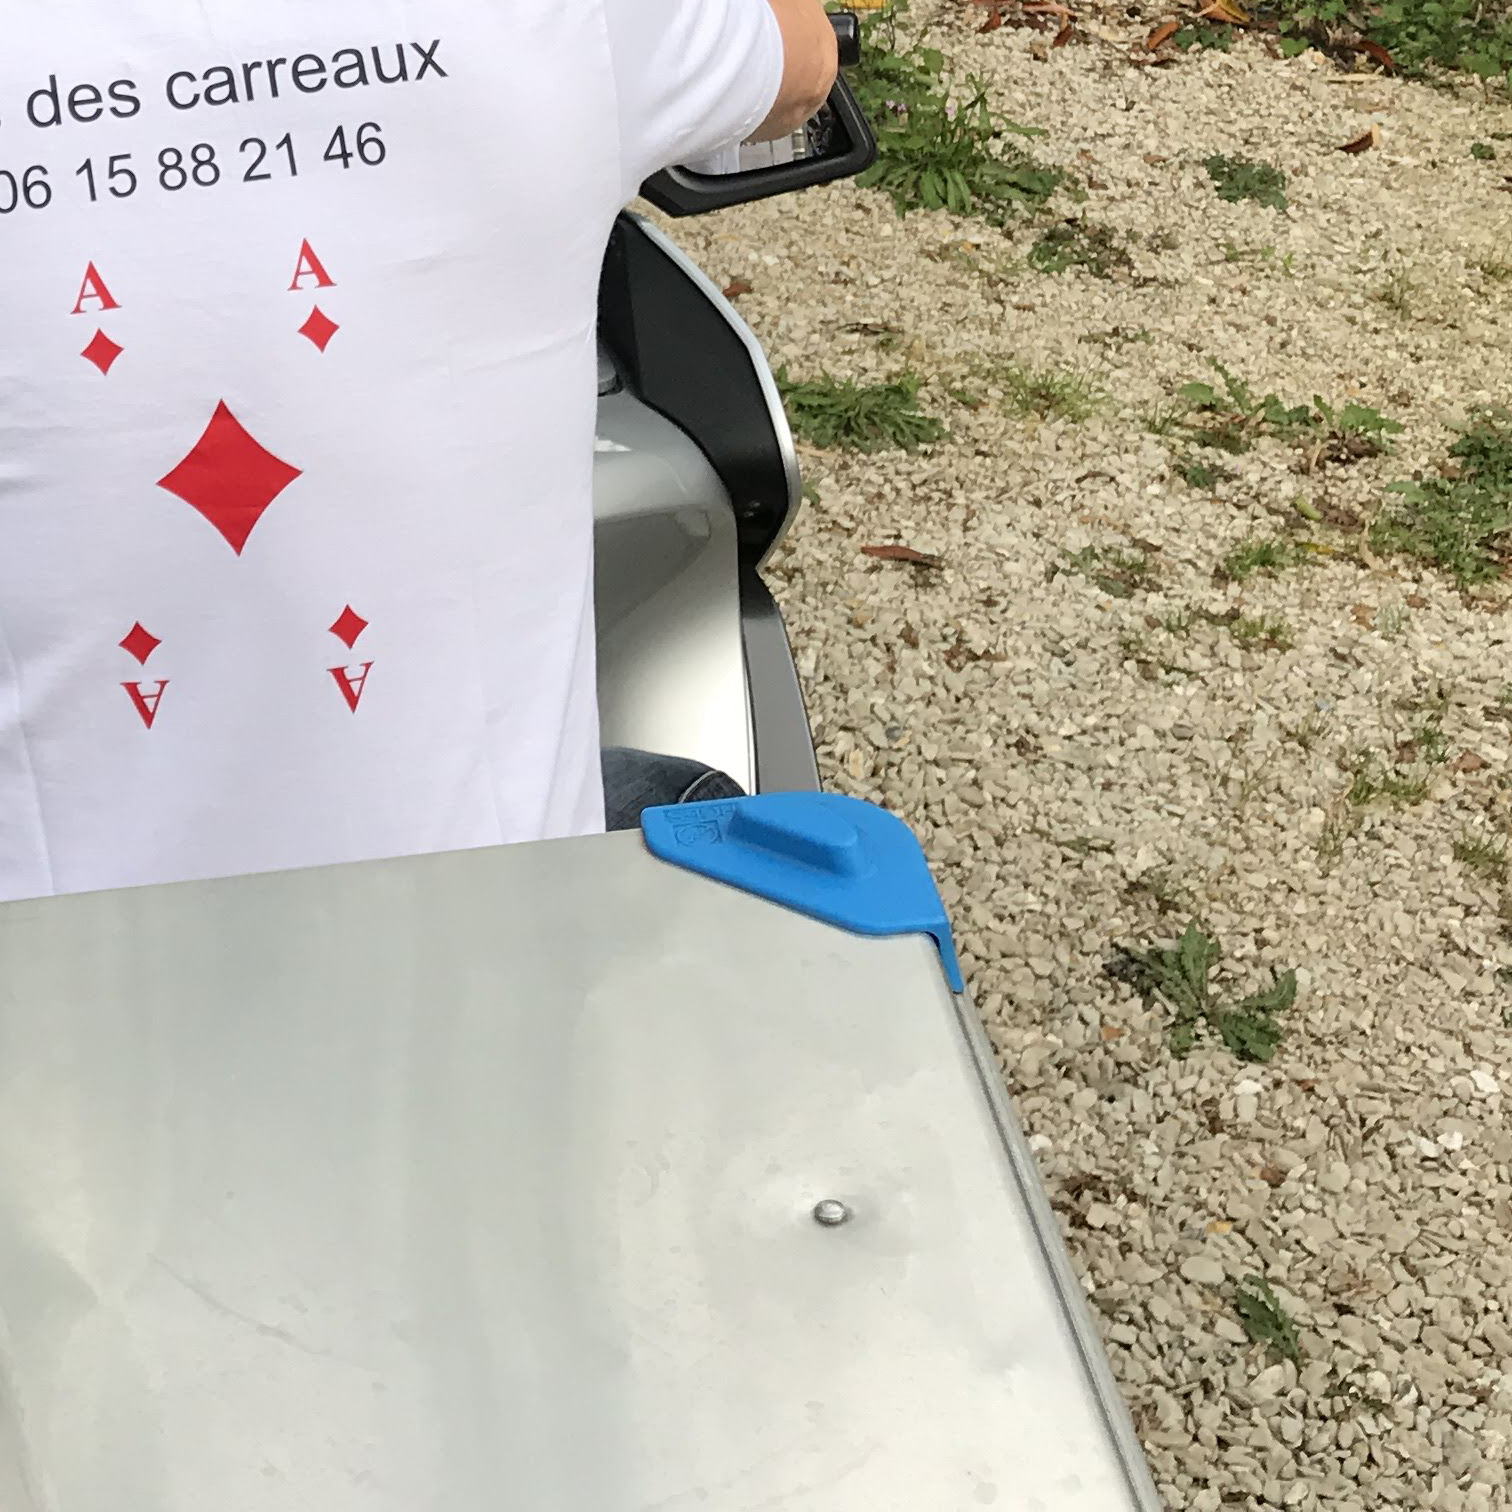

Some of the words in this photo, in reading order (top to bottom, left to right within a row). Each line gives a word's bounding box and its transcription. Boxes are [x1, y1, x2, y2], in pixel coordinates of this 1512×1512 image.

[26, 74, 142, 128] des
[165, 38, 449, 110] carreaux
[75, 152, 138, 202] 15
[157, 142, 222, 192] 88
[239, 131, 298, 183] 21
[322, 121, 387, 170] 46
[70, 260, 123, 315] A
[287, 237, 337, 291] A
[119, 679, 170, 730] A
[326, 660, 375, 714] A
